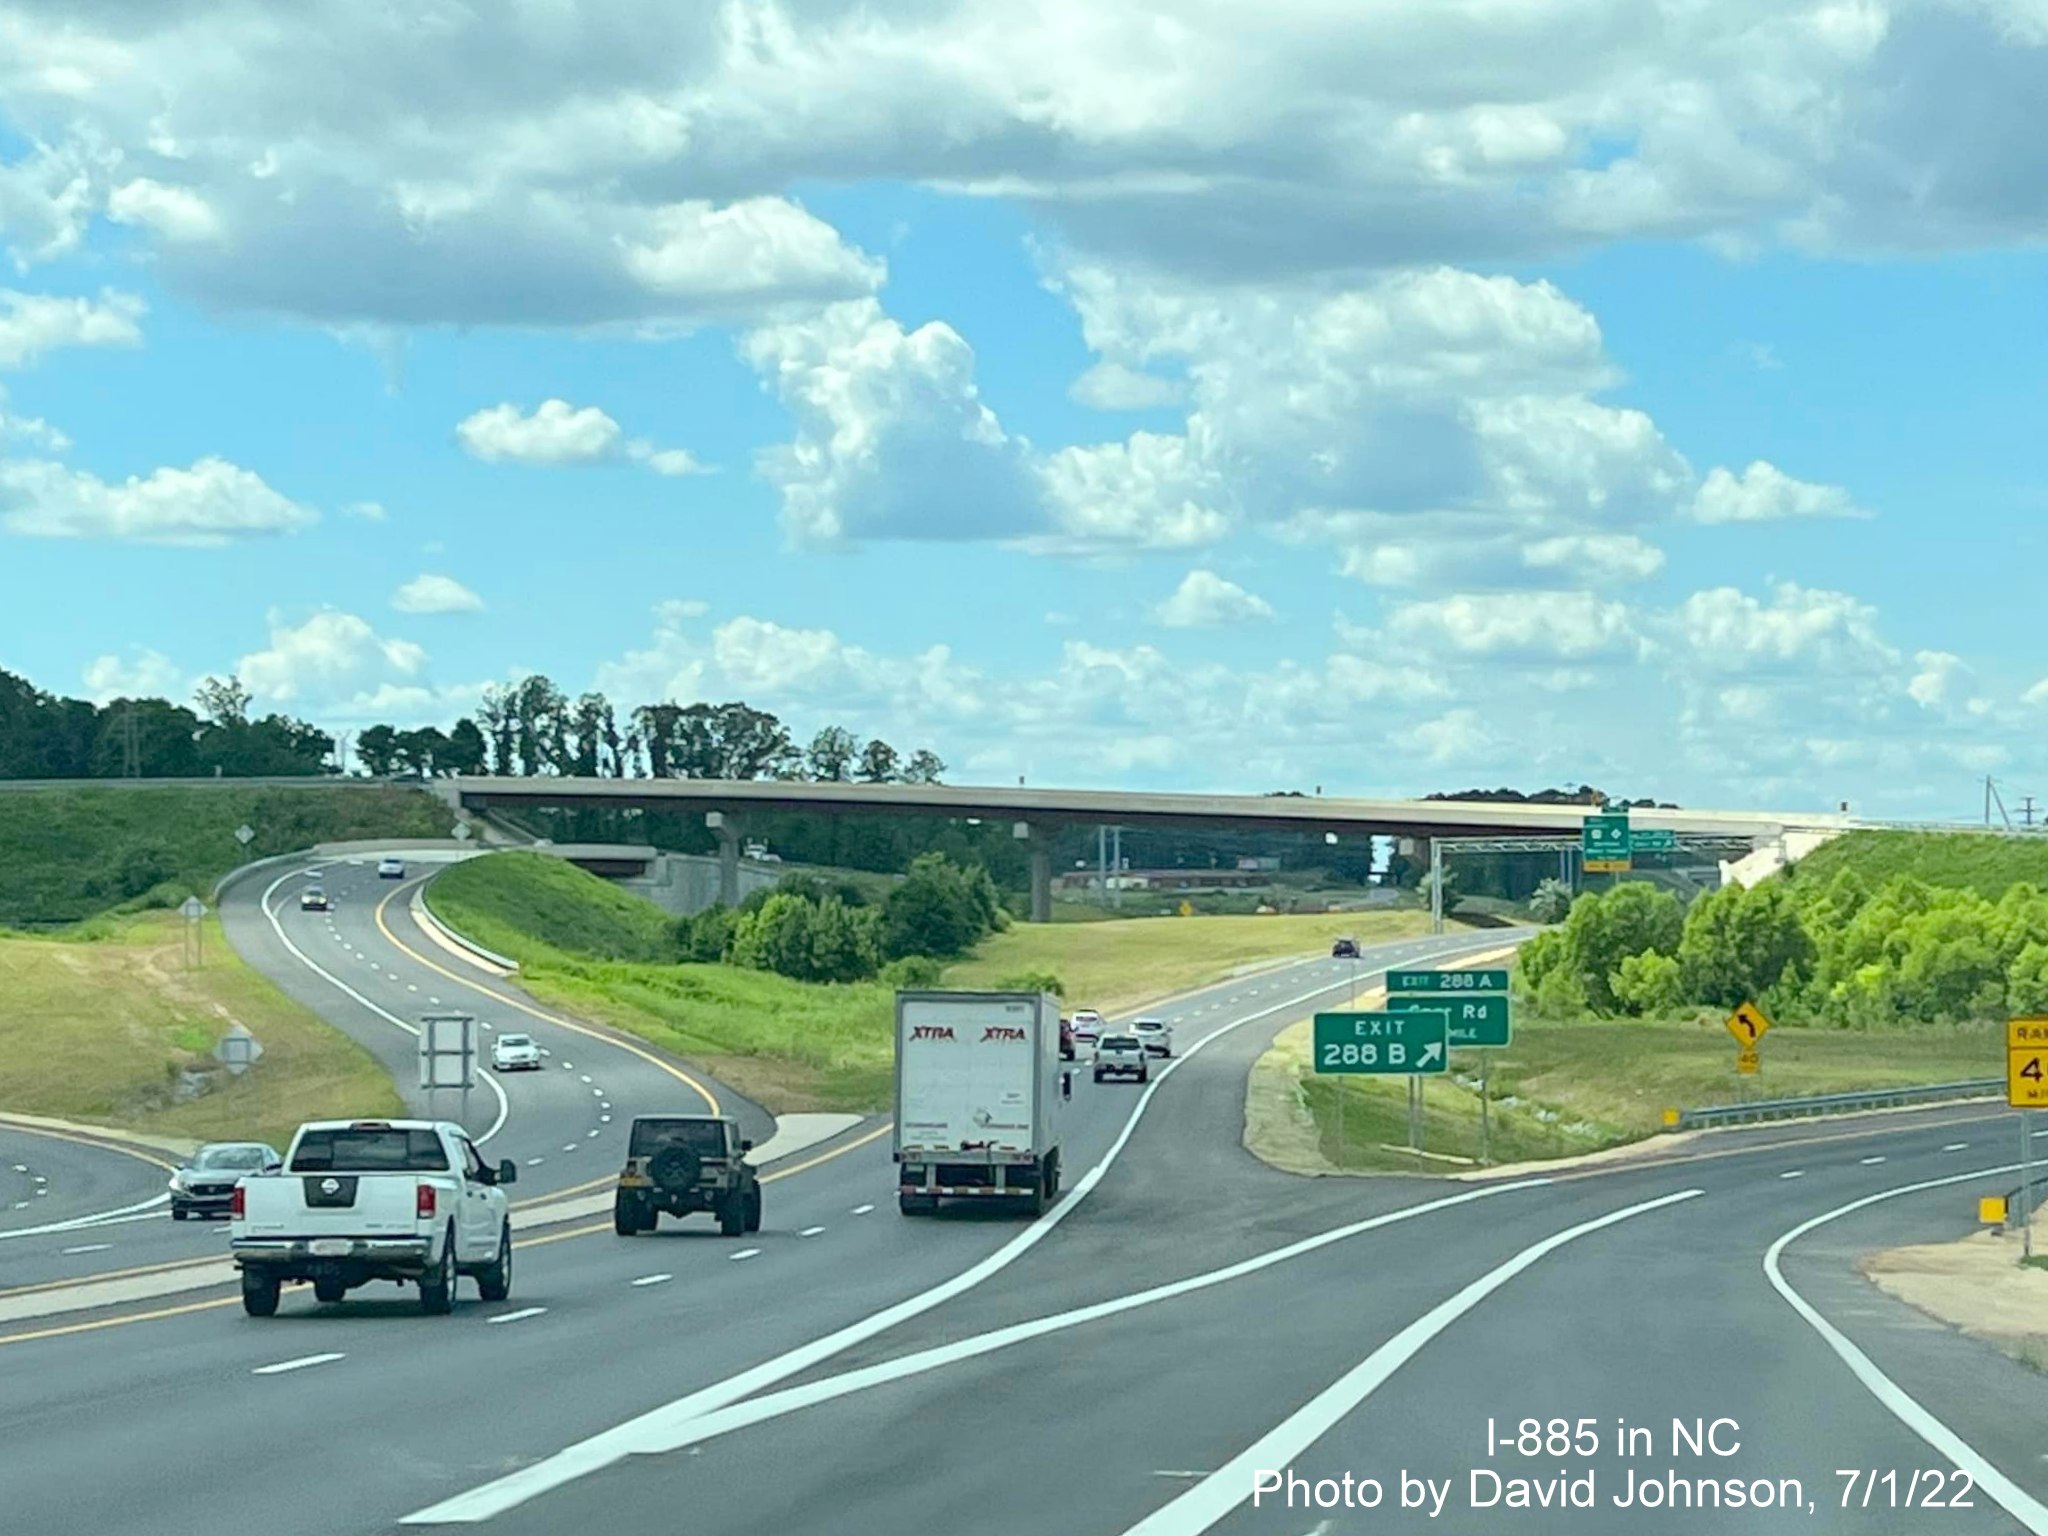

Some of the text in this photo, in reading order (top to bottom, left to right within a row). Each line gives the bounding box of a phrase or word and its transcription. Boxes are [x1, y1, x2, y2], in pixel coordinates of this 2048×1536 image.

[1440, 973, 1474, 989] 288
[1479, 973, 1492, 988] A
[1463, 1004, 1487, 1019] Rd
[909, 1026, 956, 1042] XTRA
[980, 1026, 1026, 1042] XTRA
[1355, 1020, 1405, 1036] EXIT
[1324, 1043, 1406, 1065] 288 B
